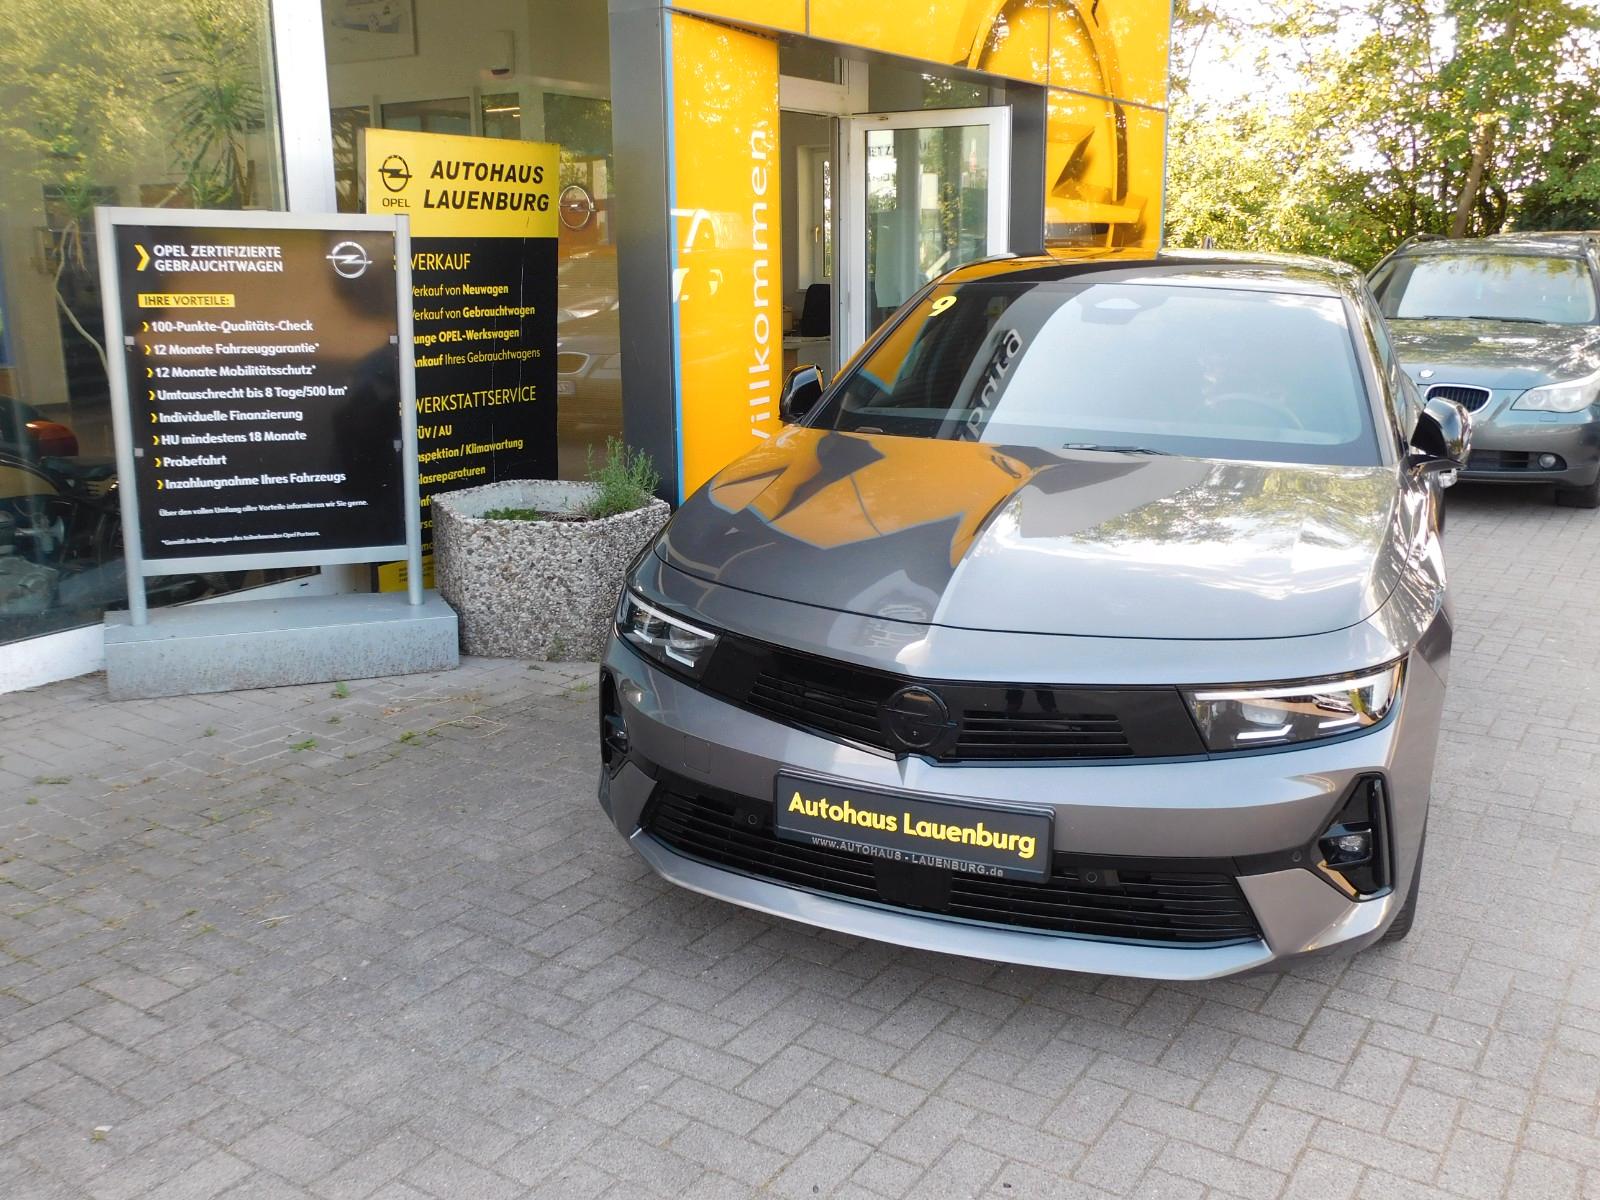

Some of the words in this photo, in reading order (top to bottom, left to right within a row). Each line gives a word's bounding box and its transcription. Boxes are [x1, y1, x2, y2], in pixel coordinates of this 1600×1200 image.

[430, 160, 544, 184] AUTOHAUS
[382, 197, 411, 208] OPEL
[423, 189, 549, 212] LAUENBURG
[153, 245, 189, 257] OPEL
[190, 245, 282, 258] ZERTIFIZIERTE
[154, 260, 284, 272] GEBRAUCHTWAGEN
[445, 287, 461, 296] von
[462, 284, 509, 297] Neuwagen
[749, 131, 770, 439] illkommen
[144, 296, 171, 306] IHRE
[173, 296, 230, 306] VORTEILE:
[444, 310, 461, 319] von
[462, 305, 535, 318] Gebrauchtwagen
[152, 319, 313, 334] 100-Punkte-Qualitäts-Check
[413, 334, 437, 347] unge
[438, 328, 519, 342] OPEL-Werkswagen
[154, 345, 167, 355] 12
[169, 345, 213, 356] Monate
[445, 353, 466, 365] Ihres
[467, 349, 541, 364] Gebrauchtwagens
[156, 367, 170, 378] 12
[171, 367, 217, 378] Monate
[157, 387, 245, 401] Umtauschrecht
[246, 387, 264, 399] bis
[265, 387, 273, 399] 8
[275, 385, 326, 400] Tage/500
[159, 410, 229, 423] Individuelle
[229, 409, 303, 422] Finanzierung
[161, 434, 180, 445] HU
[181, 432, 248, 444] mindestens
[249, 431, 262, 442] 18
[264, 430, 307, 442] Monate
[417, 425, 431, 439] ÜV
[438, 424, 453, 437] AU
[465, 438, 523, 456] Klimawartung
[162, 454, 227, 467] Probefahrt
[165, 475, 260, 490] Inzahlungnahme
[261, 474, 288, 485] Ihres
[290, 472, 346, 485] Fahrzeugs
[418, 466, 486, 485] lasreparaturen
[788, 791, 898, 832] Autohaus
[903, 813, 1036, 859] Lauenburg
